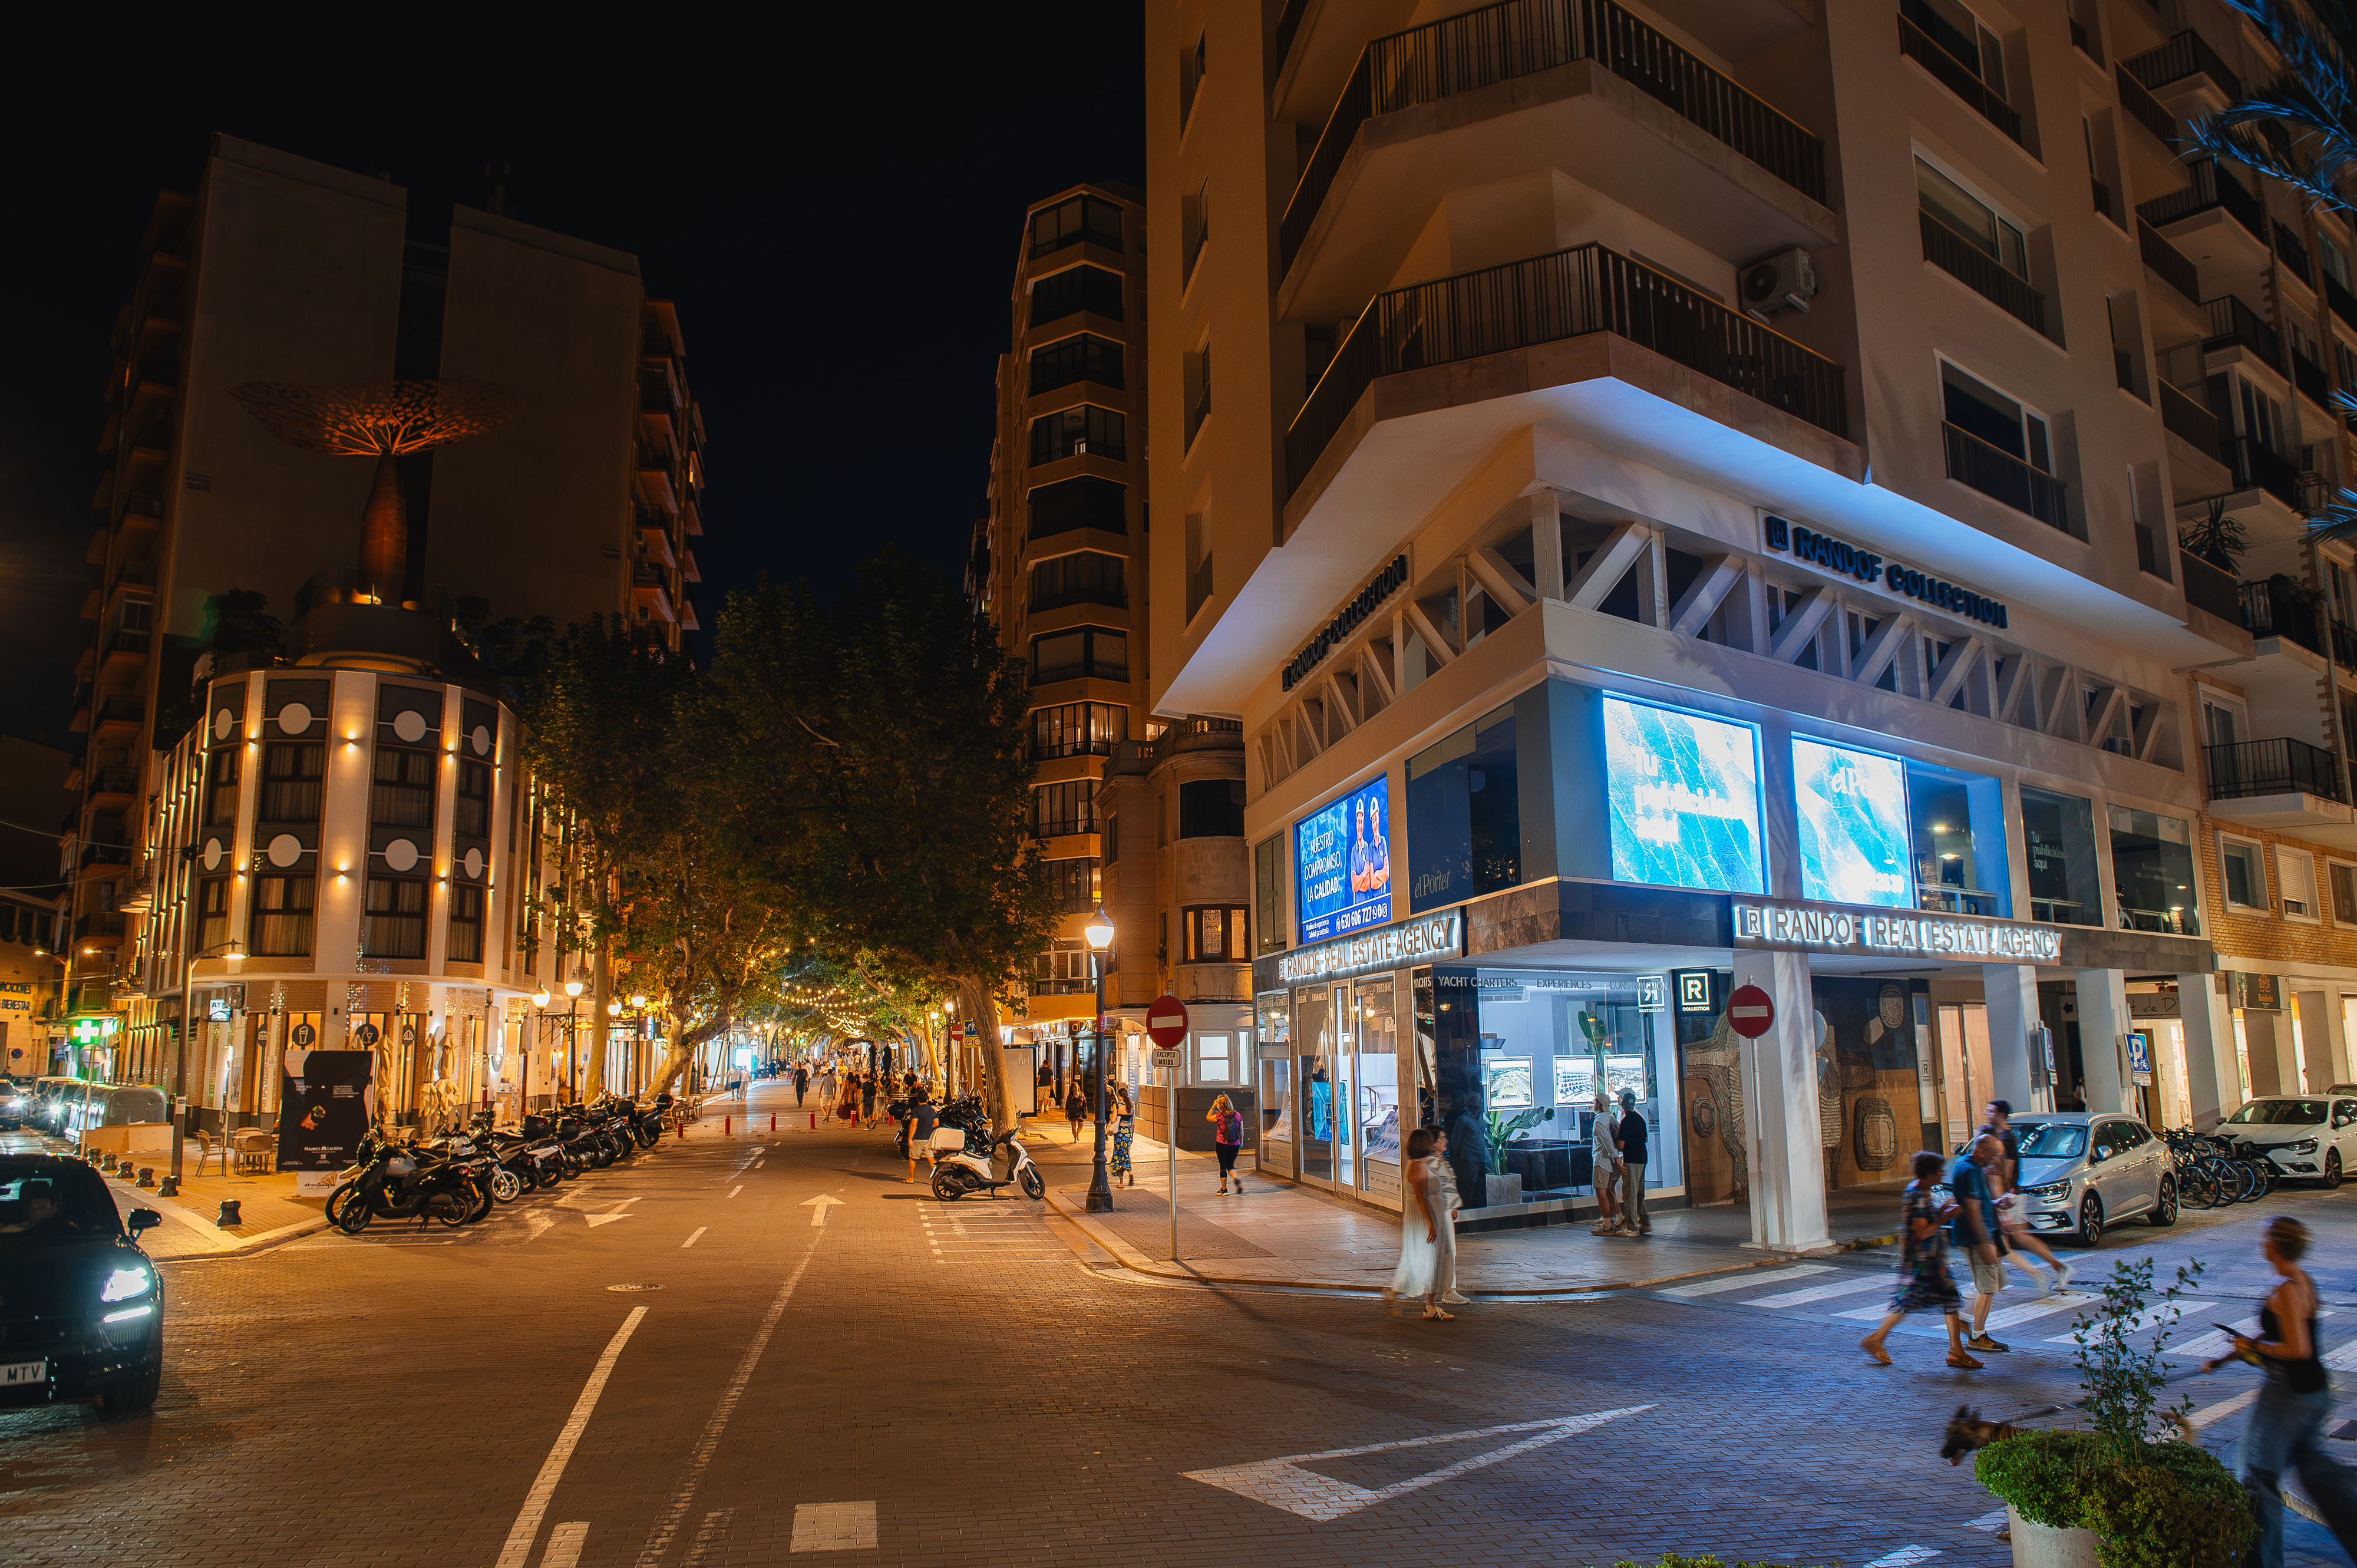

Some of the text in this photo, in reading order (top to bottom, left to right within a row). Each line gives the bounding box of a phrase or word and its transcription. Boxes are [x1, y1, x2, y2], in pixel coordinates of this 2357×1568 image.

[1794, 526, 1883, 582] RANDOF
[1886, 563, 2008, 629] COLLECTION
[1291, 629, 1329, 683] RANDOF
[1329, 554, 1407, 644] COLLECTION
[1631, 746, 1658, 776] Tu
[1310, 830, 1334, 856] NUESTRO
[1304, 851, 1342, 881] COMPROMISO,
[1307, 876, 1340, 903] LA CALIDAD.
[1341, 905, 1372, 930] 630 606 727
[1288, 951, 1319, 976] RANDOF
[1325, 943, 1349, 971] REAL
[1353, 933, 1391, 965] ESTATE
[1397, 918, 1453, 955] AGENCY
[1775, 909, 1862, 943] RANDOF
[1875, 917, 1923, 948] REAL
[1932, 922, 1995, 952] ESTATE
[2002, 927, 2062, 957] AGENCY
[1414, 976, 1667, 991] YACHTS YACHT CHARTERS EXPERIENCES CONSTRUCTION
[2143, 996, 2158, 1012] de
[7, 1365, 40, 1382] MTV
